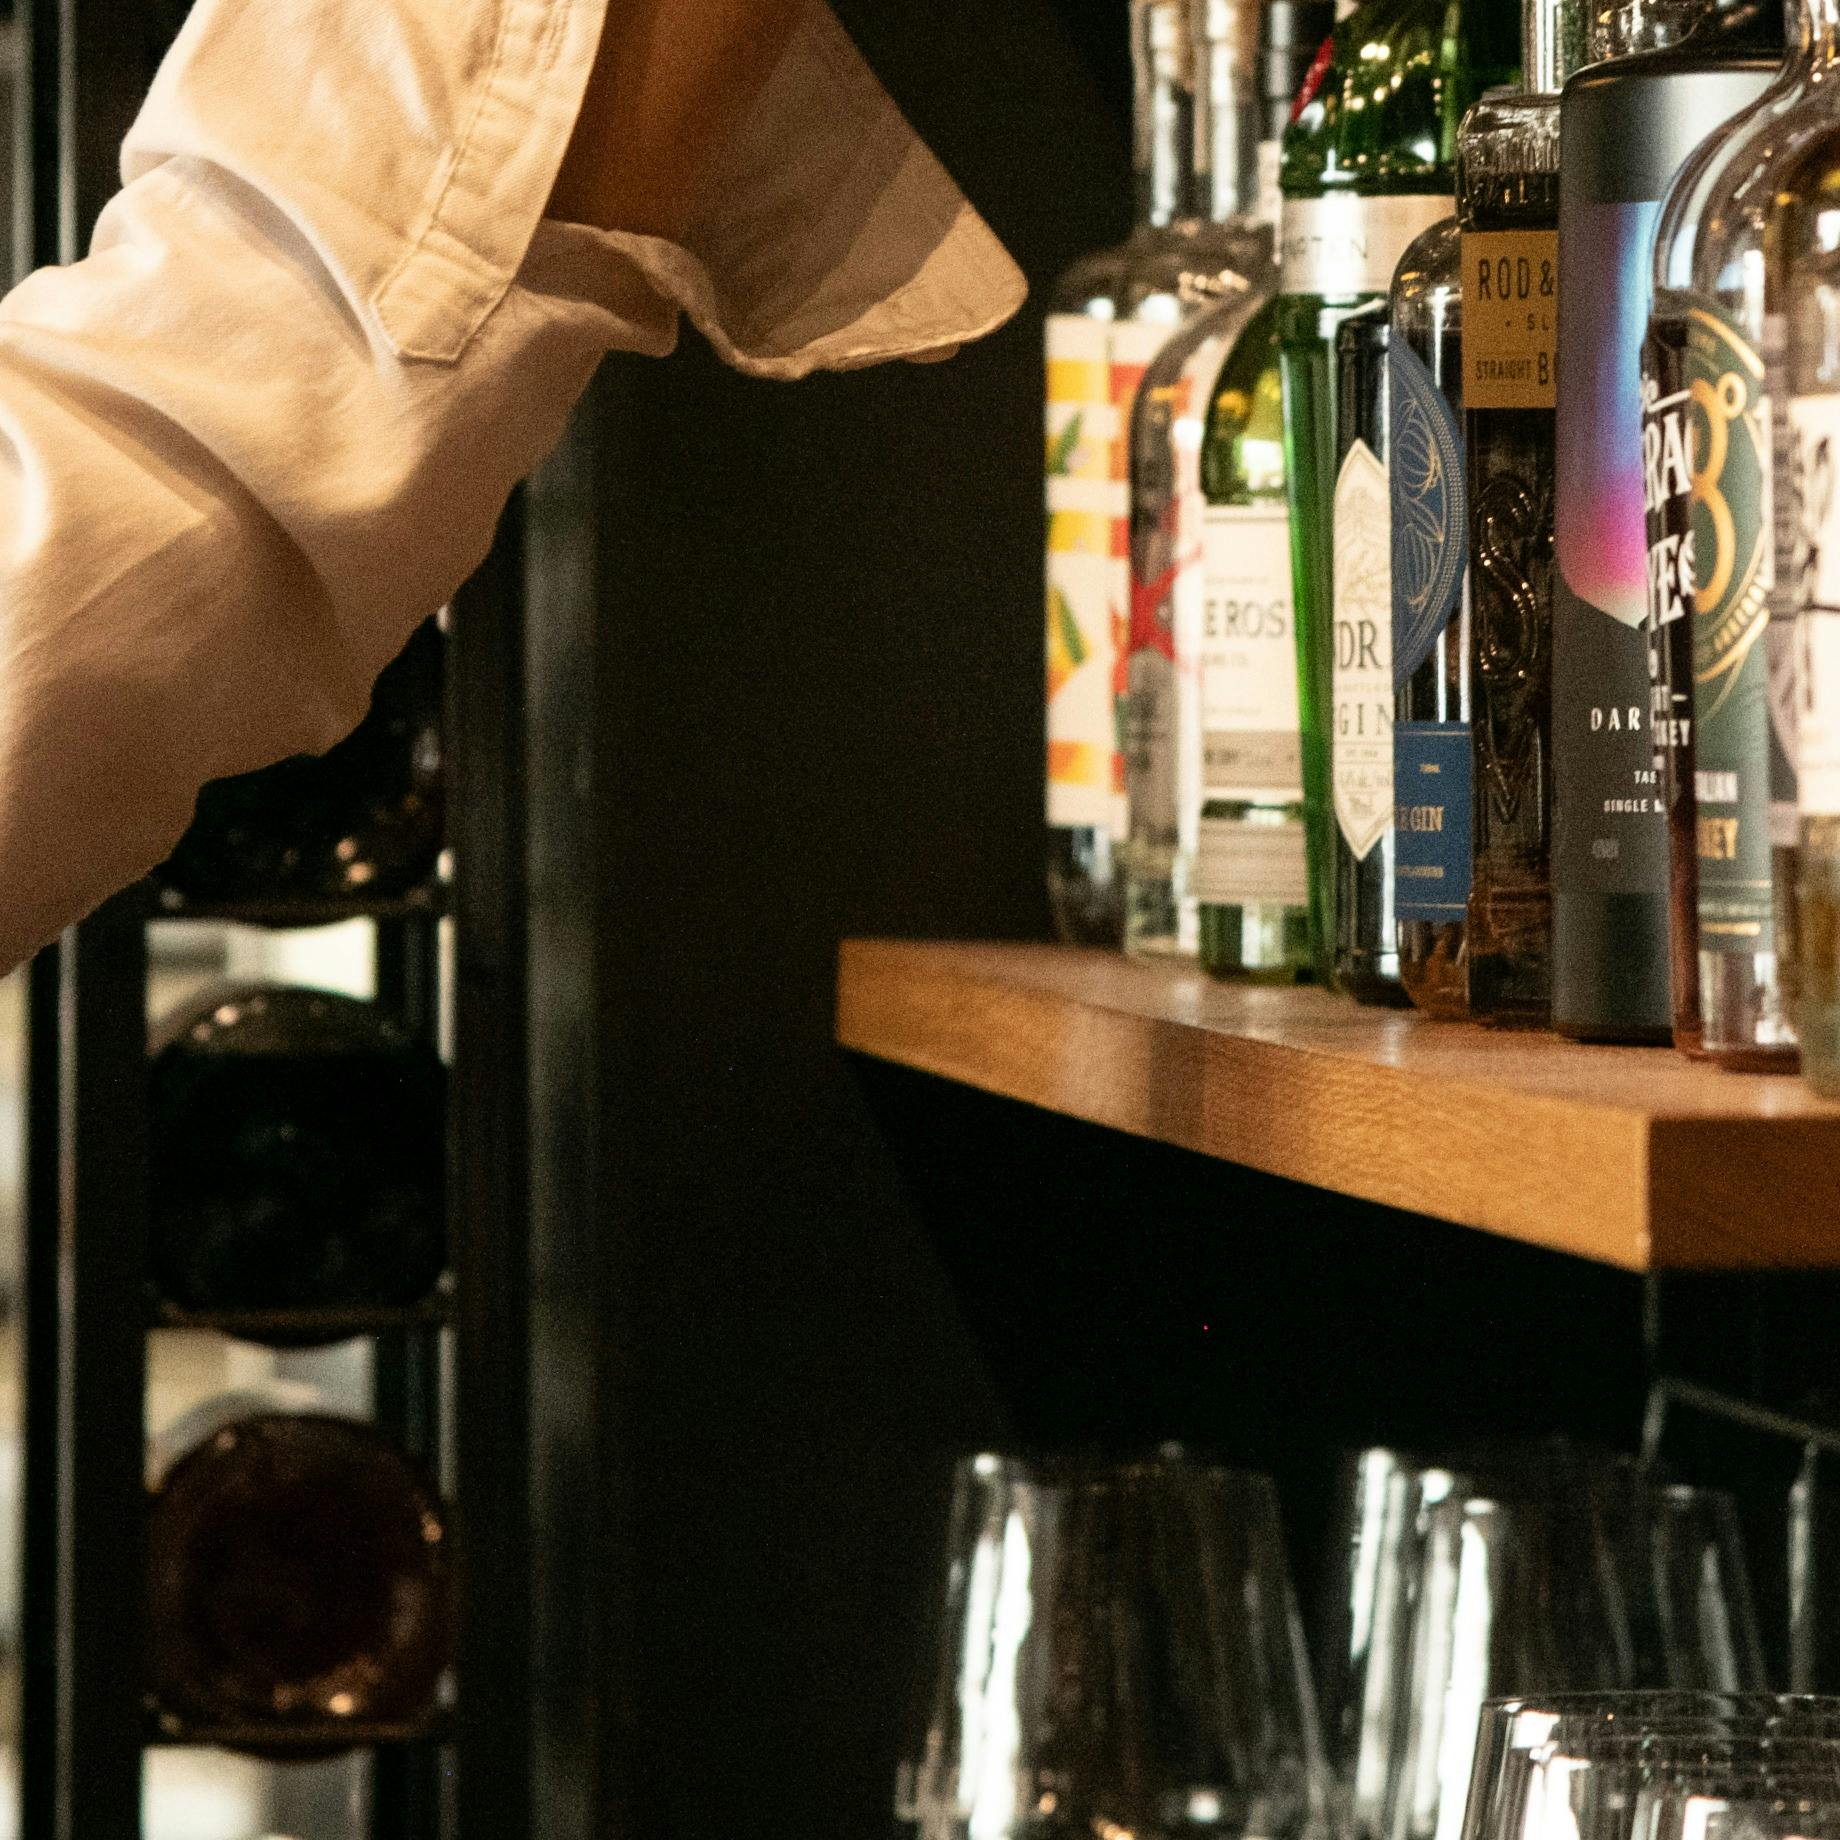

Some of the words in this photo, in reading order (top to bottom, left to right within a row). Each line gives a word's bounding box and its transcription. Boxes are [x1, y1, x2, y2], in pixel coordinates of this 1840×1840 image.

[1478, 256, 1530, 300] ROD
[1540, 260, 1553, 296] &
[1604, 799, 1648, 813] SINGLE
